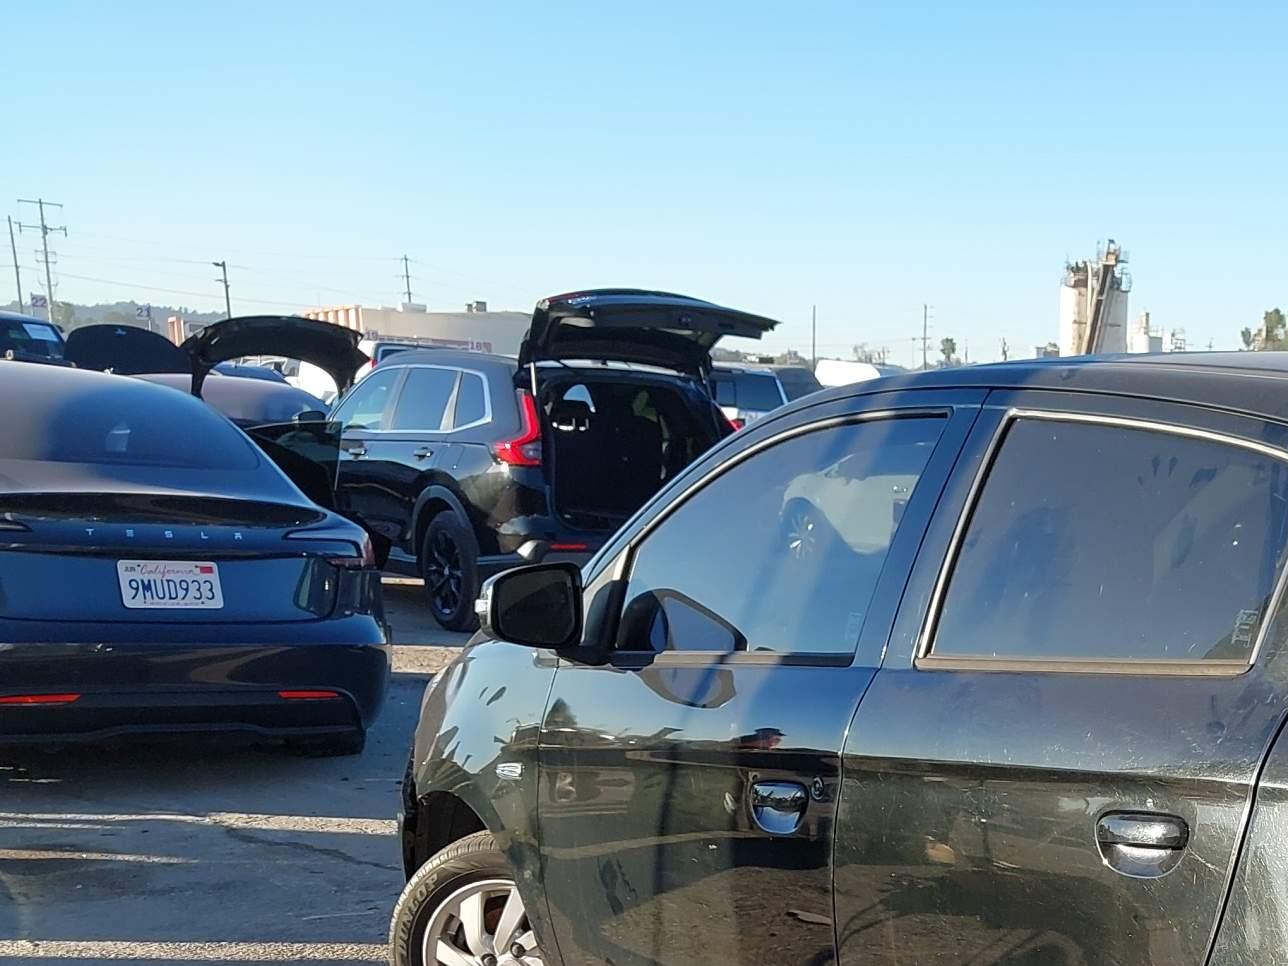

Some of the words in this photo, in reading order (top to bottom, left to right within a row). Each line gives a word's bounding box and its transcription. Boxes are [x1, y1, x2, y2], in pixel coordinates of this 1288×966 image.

[136, 306, 151, 318] 21
[86, 528, 243, 540] TESLA
[140, 563, 201, 578] California
[128, 578, 215, 601] 9MUD933
